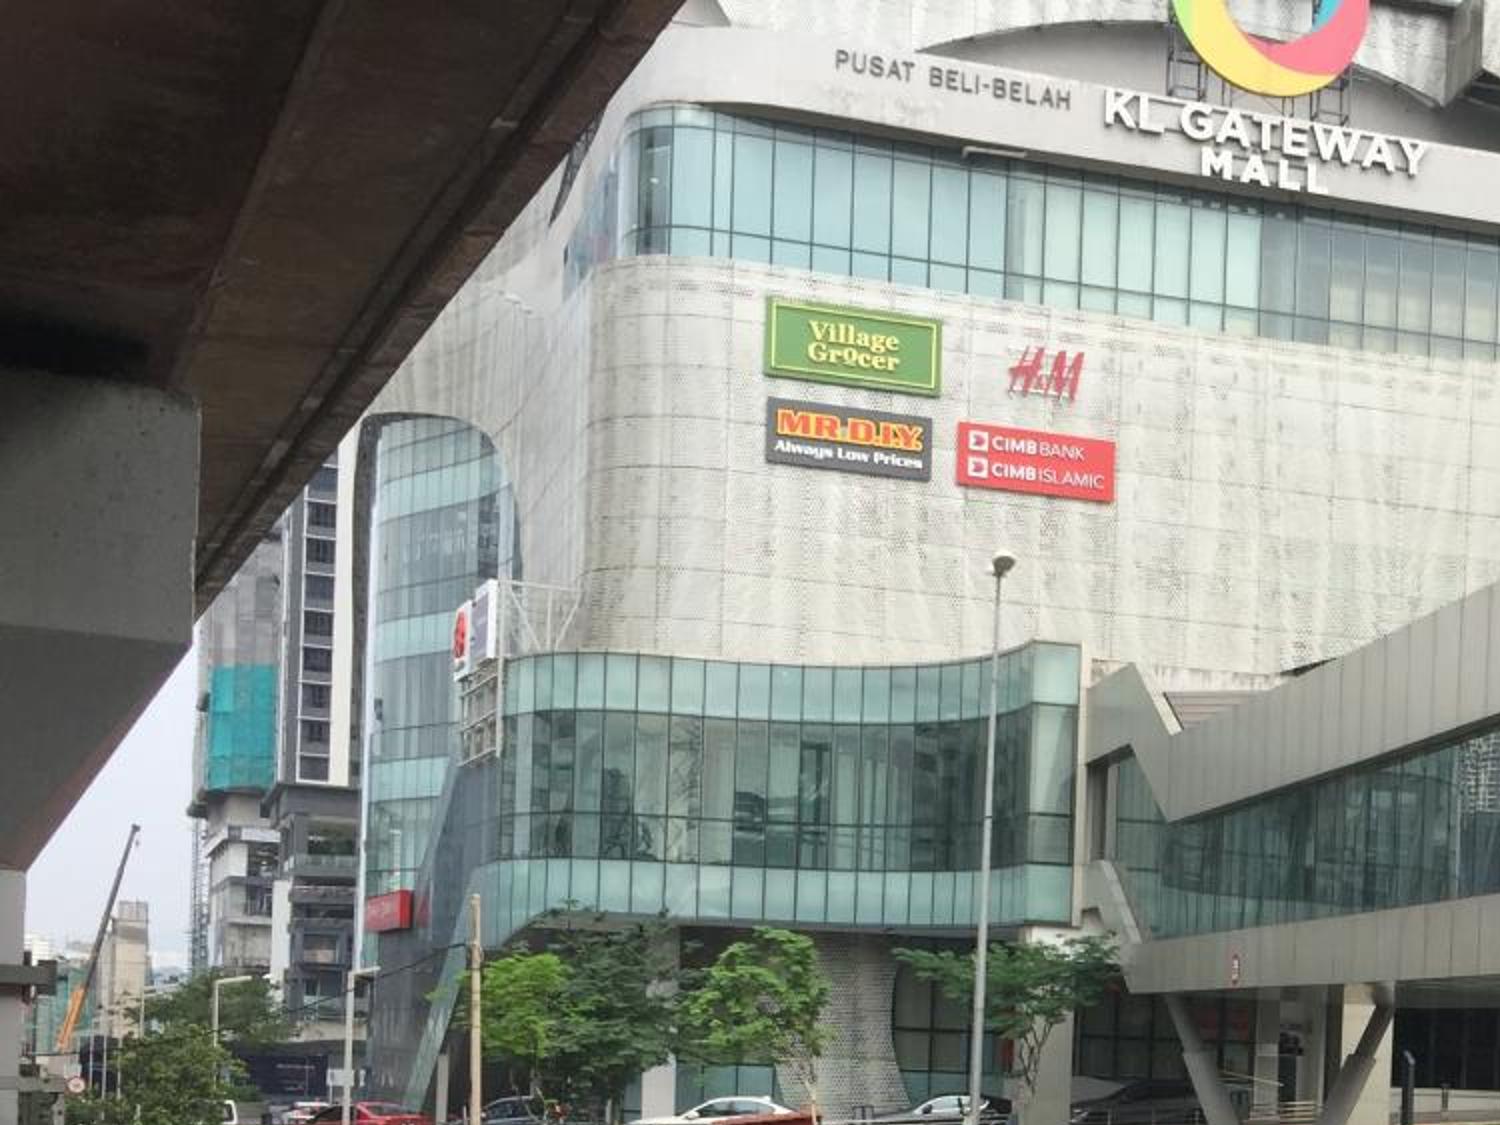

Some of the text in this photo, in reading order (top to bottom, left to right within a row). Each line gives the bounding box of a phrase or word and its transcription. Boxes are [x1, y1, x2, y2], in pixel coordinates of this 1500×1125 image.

[834, 49, 1072, 111] PUSAT BELI-BELAH
[1104, 88, 1427, 178] KL GATEWAY
[1201, 146, 1330, 196] MALL
[808, 319, 900, 353] Village
[808, 342, 900, 371] Grocer
[775, 439, 923, 470] Always Low Prices
[991, 435, 1086, 462] CIMB BANK
[991, 461, 1105, 490] CIMB ISLAMIC
